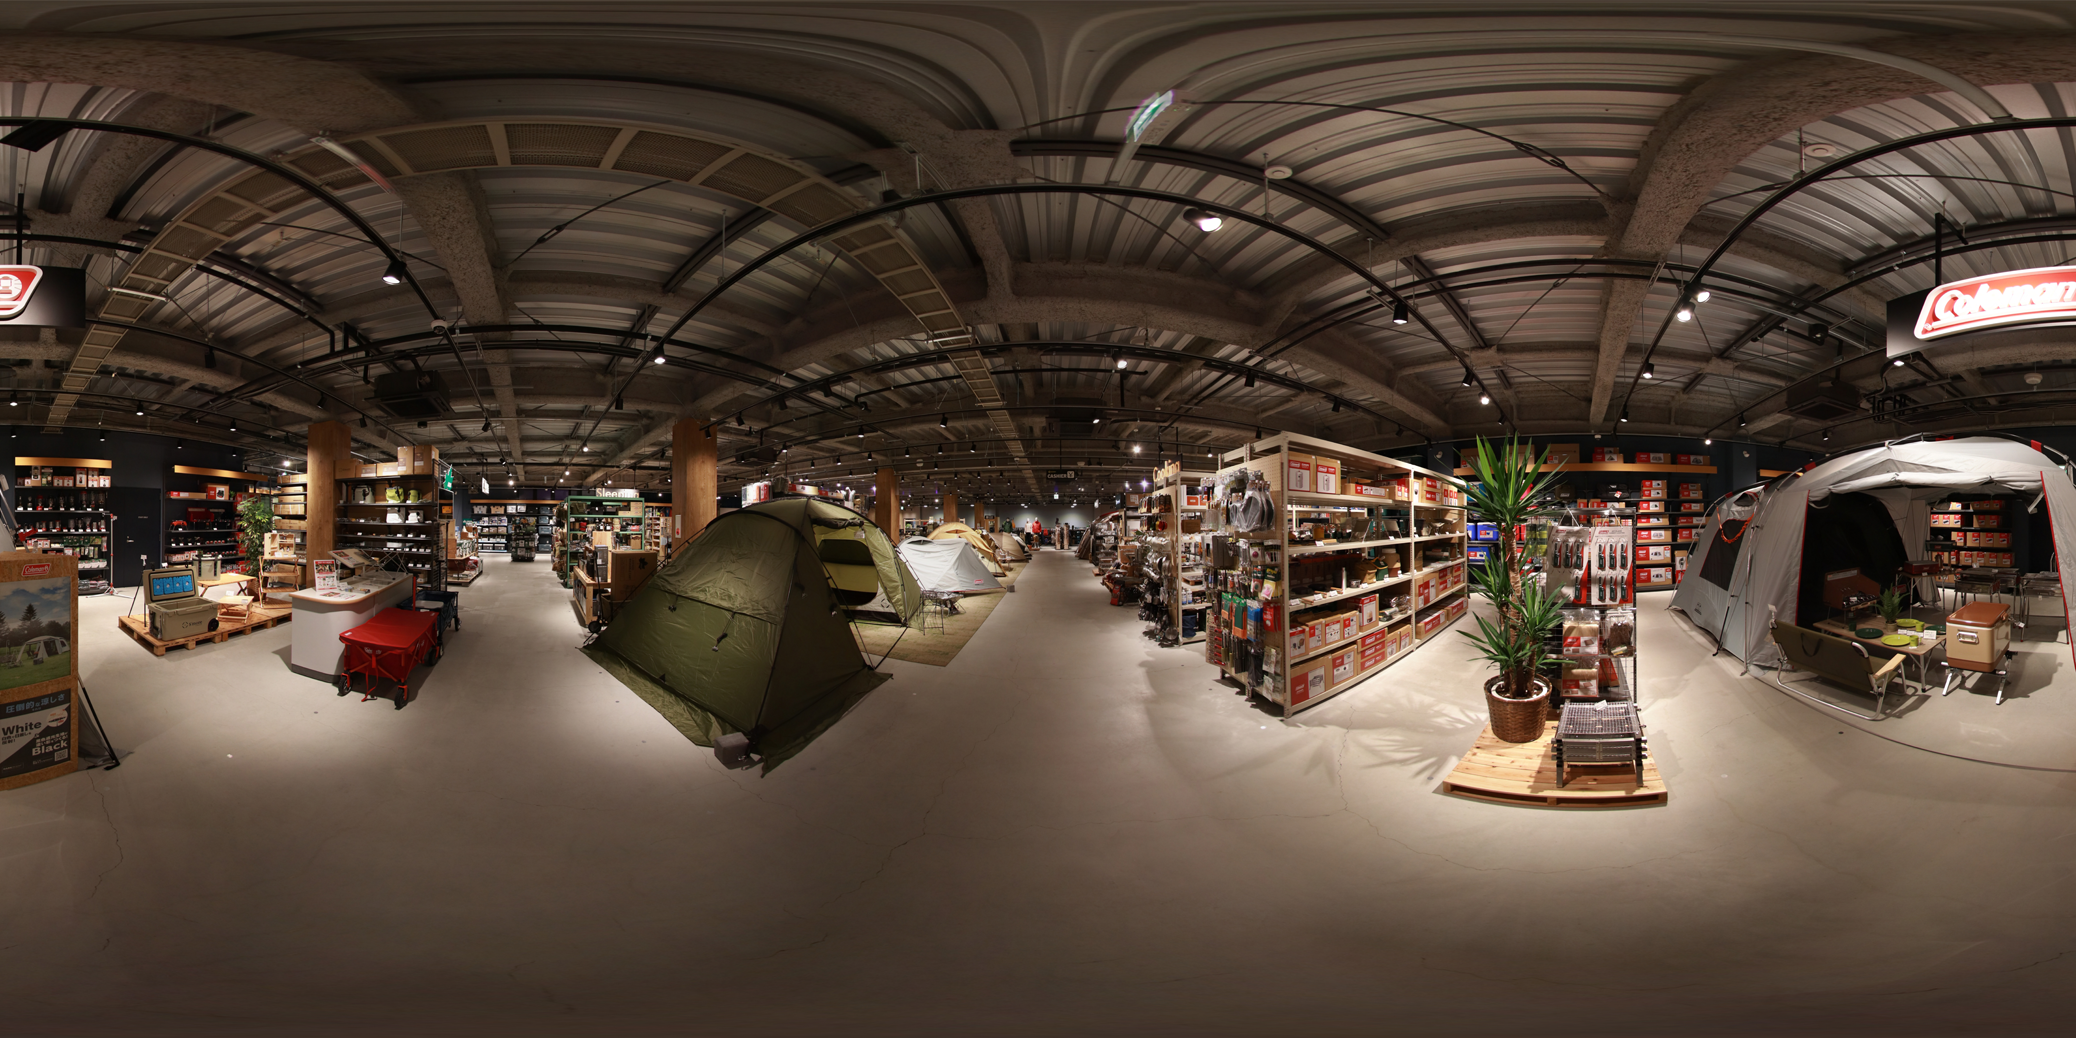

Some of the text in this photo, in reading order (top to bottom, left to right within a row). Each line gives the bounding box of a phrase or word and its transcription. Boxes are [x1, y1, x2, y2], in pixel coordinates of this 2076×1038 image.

[1934, 281, 2076, 321] Coleman
[6, 693, 65, 713] 圧倒的な涼しさ
[2, 721, 42, 736] White
[32, 740, 68, 757] Black
